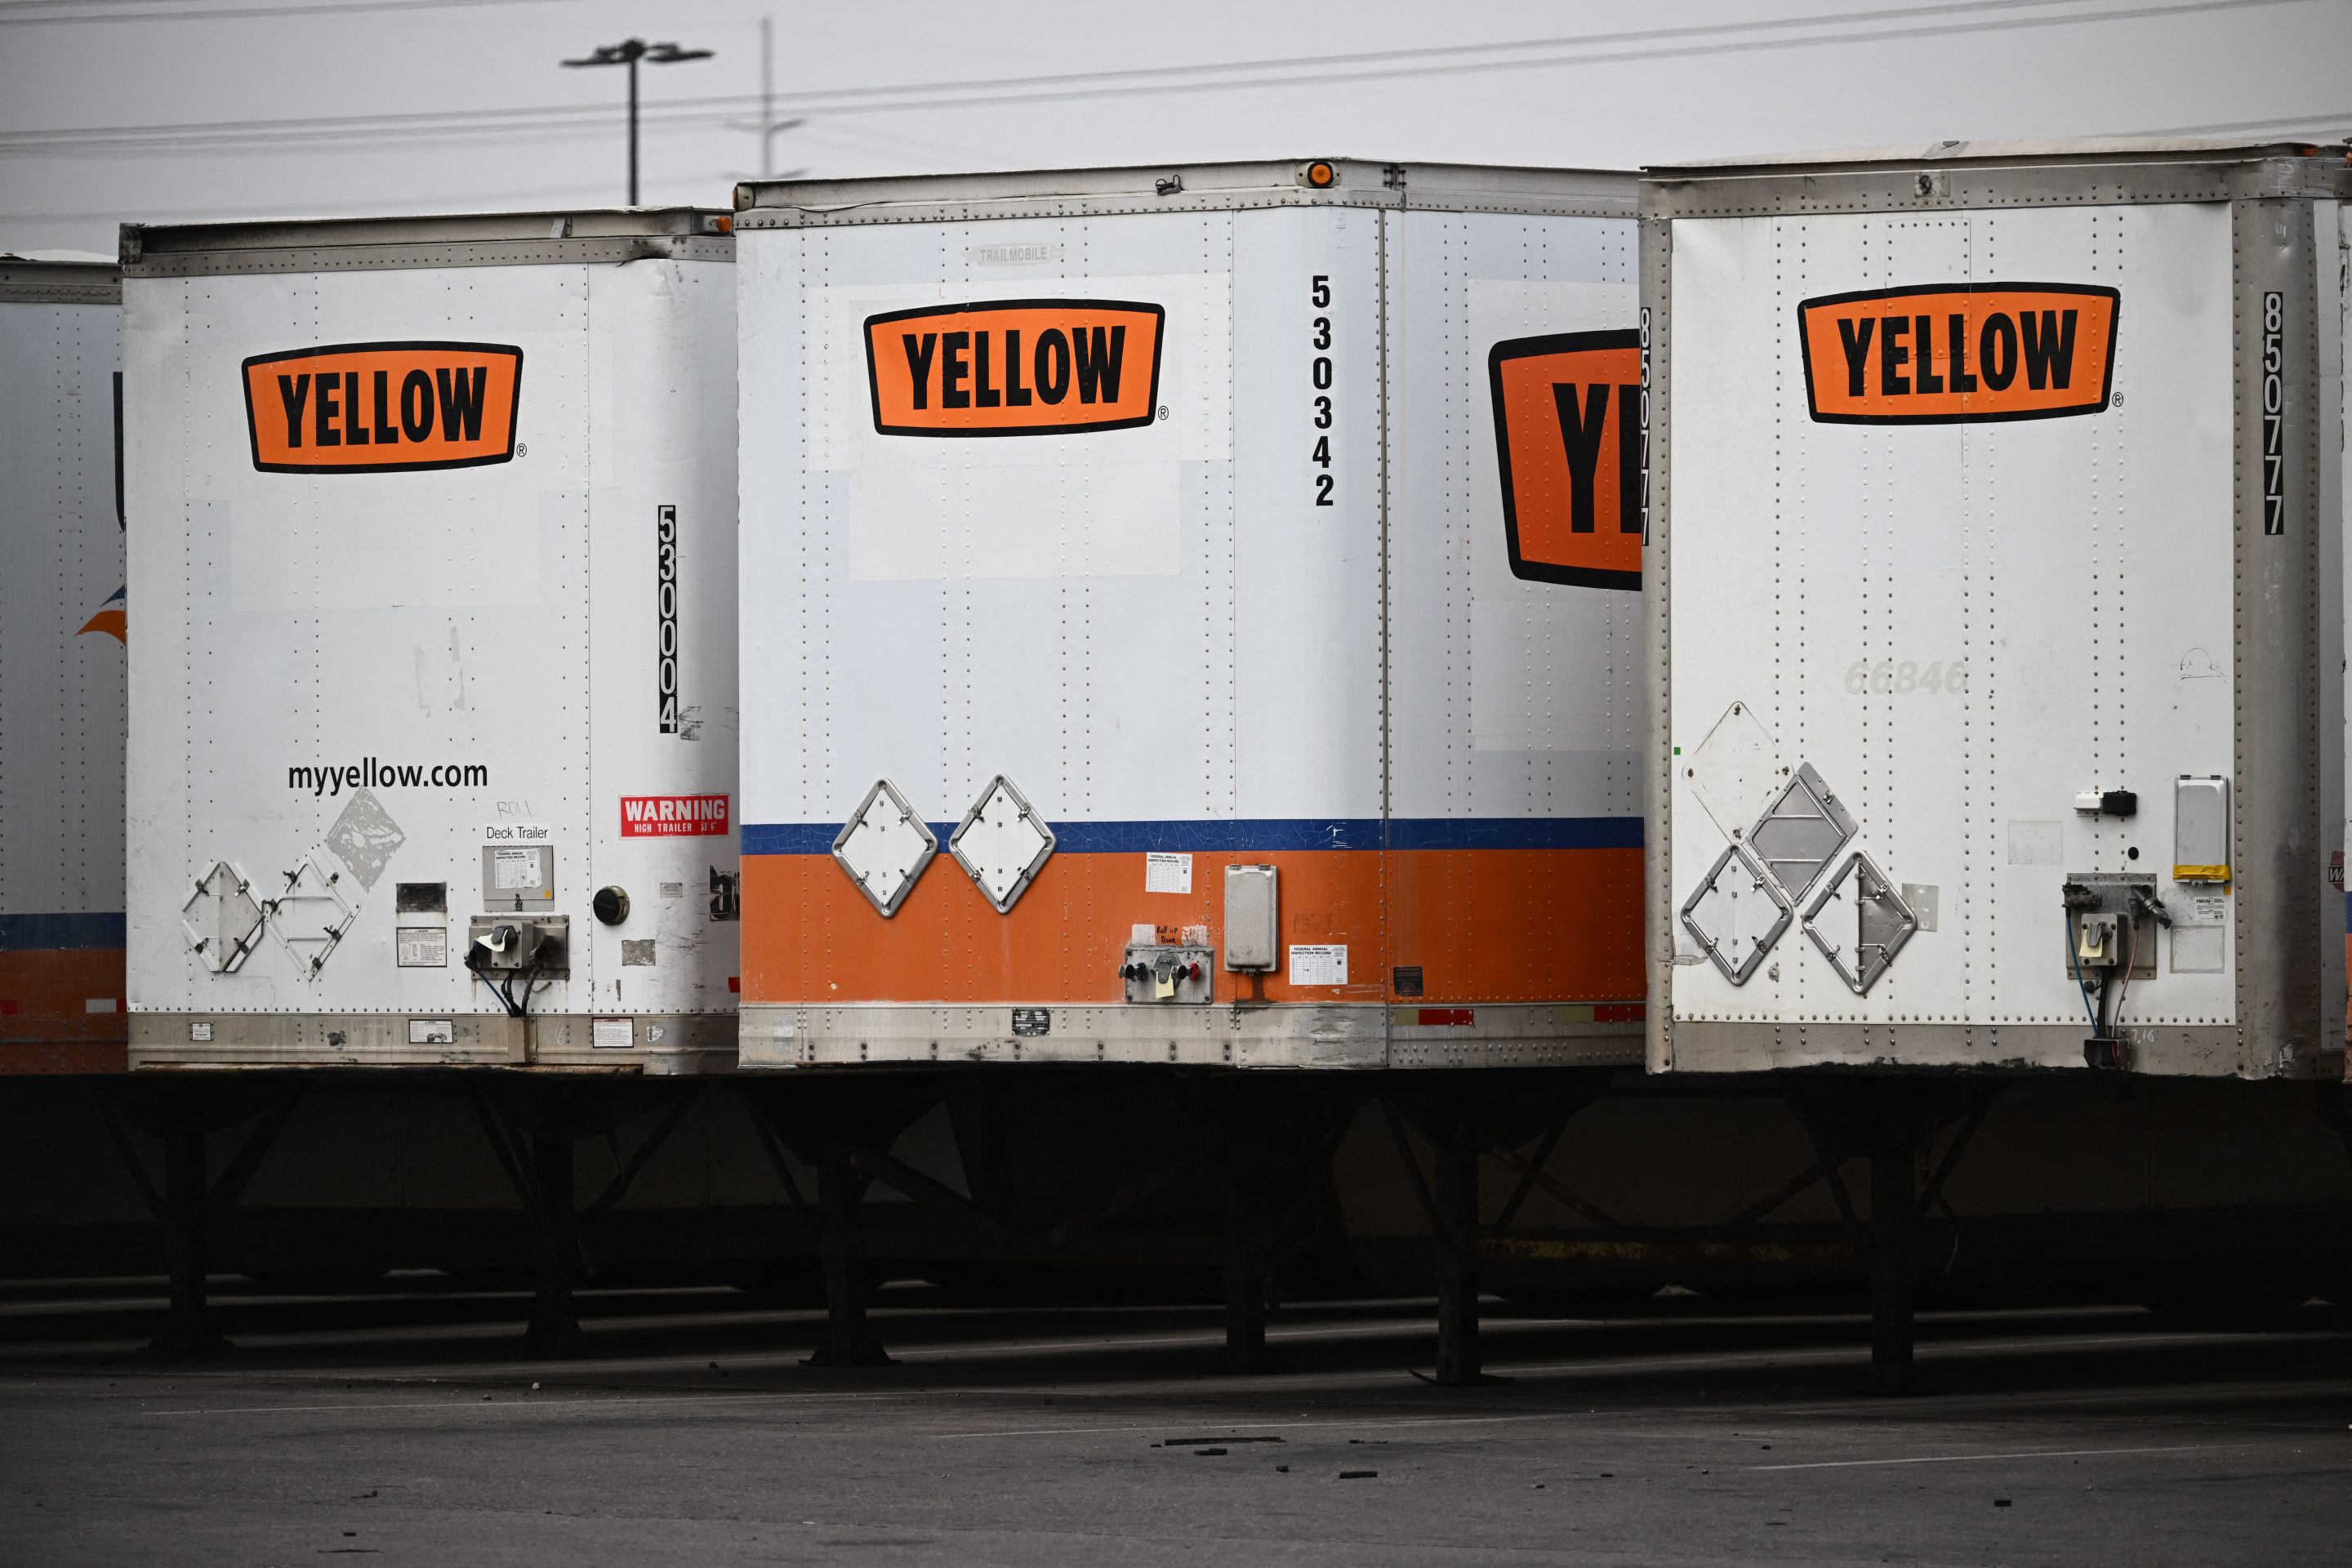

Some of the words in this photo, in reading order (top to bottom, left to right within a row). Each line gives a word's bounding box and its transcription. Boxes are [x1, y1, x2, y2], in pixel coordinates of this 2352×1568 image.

[980, 247, 1047, 262] TRAILMOBILE
[902, 325, 1126, 410] YELLOW
[1838, 309, 2078, 397] YELLOW
[278, 366, 488, 448] YELLOW
[1312, 275, 1334, 506] 530342
[2264, 292, 2283, 536] 850777
[1641, 307, 1651, 546] 850777
[658, 506, 677, 733] 530004
[1844, 660, 1970, 696] 66846
[289, 756, 488, 797] myyellow.com
[486, 826, 514, 839] Deck
[516, 826, 549, 839] Trailer
[497, 800, 537, 819] ROLL
[625, 799, 725, 822] WARNING
[634, 822, 652, 833] HIGH
[657, 822, 693, 833] TRAILER
